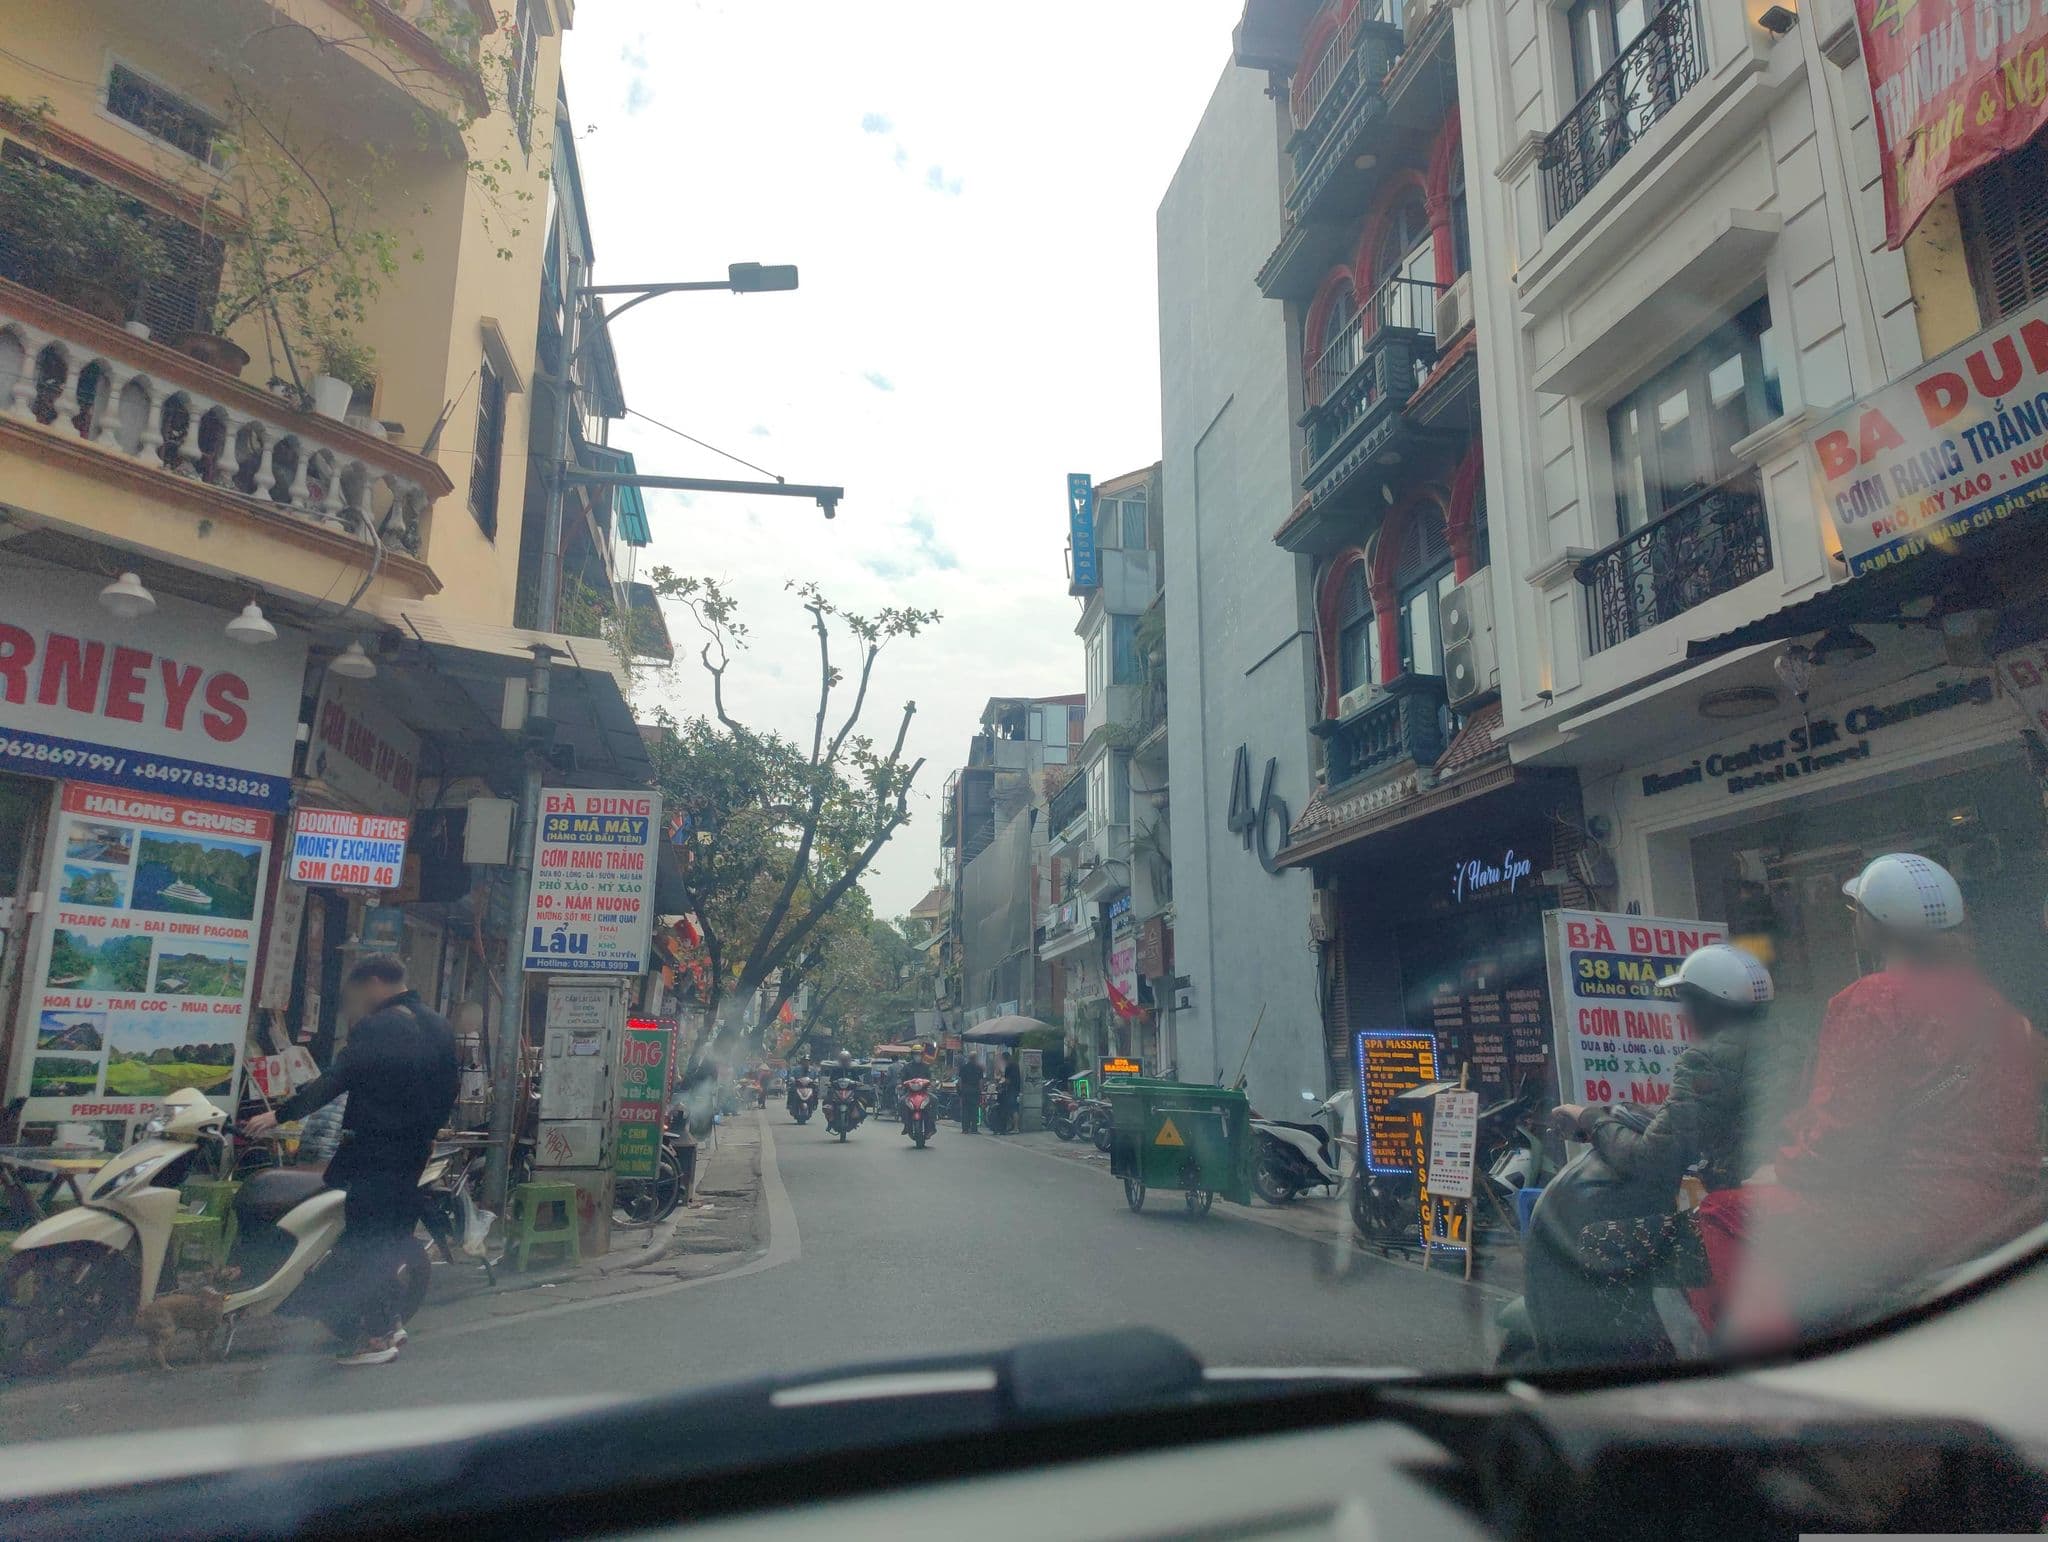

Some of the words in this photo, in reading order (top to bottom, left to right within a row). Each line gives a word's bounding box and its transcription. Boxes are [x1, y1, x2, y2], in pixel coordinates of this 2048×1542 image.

[1835, 474, 1891, 525] CƠM
[1889, 439, 1965, 498] RANG
[1949, 471, 1992, 506] XÀO
[133, 762, 270, 798] +84978333828
[85, 794, 176, 823] HALONG
[180, 809, 257, 835] CRUISE
[1228, 742, 1290, 875] 46
[298, 811, 359, 835] BOOKING
[361, 817, 407, 840] OFFICE
[548, 818, 569, 831] 38
[573, 816, 600, 832] MÃ
[604, 818, 645, 834] MÂY
[296, 835, 341, 859] MONEY
[340, 839, 402, 864] EXCHANGE
[541, 849, 568, 868] CƠM
[570, 850, 603, 870] RANG
[606, 846, 645, 871] TRẮNG
[298, 860, 327, 881] SIM
[331, 863, 370, 884] CARD
[373, 866, 394, 885] 4G
[1468, 860, 1500, 891] Haru
[1503, 850, 1533, 893] Spa
[59, 912, 107, 928] TRANG
[111, 917, 131, 930] AN
[144, 920, 165, 932] BAI
[169, 923, 200, 935] DINH
[204, 927, 249, 940] PAGODA
[531, 922, 589, 954] Lẩu
[1567, 919, 1616, 951] BÀ
[536, 958, 571, 968] Hotline:
[1579, 959, 1611, 979] 38
[1618, 960, 1657, 981] MÃ
[43, 995, 71, 1007] HOA
[76, 996, 93, 1008] LU
[108, 998, 136, 1011] TAM
[141, 999, 168, 1012] COC
[181, 1001, 208, 1014] MUA
[212, 1002, 243, 1015] CAVE
[1578, 1007, 1621, 1037] CƠM
[1624, 1010, 1674, 1041] RANG
[1364, 1039, 1384, 1049] SPA
[1386, 1040, 1431, 1050] MASSAGE
[1584, 1054, 1619, 1072] PHỞ
[1624, 1056, 1662, 1074] XÀO
[1585, 1076, 1612, 1102] BÒ
[71, 1103, 136, 1116] PERFUME
[636, 1109, 658, 1120] POT
[1411, 1112, 1432, 1241] MASSAGE
